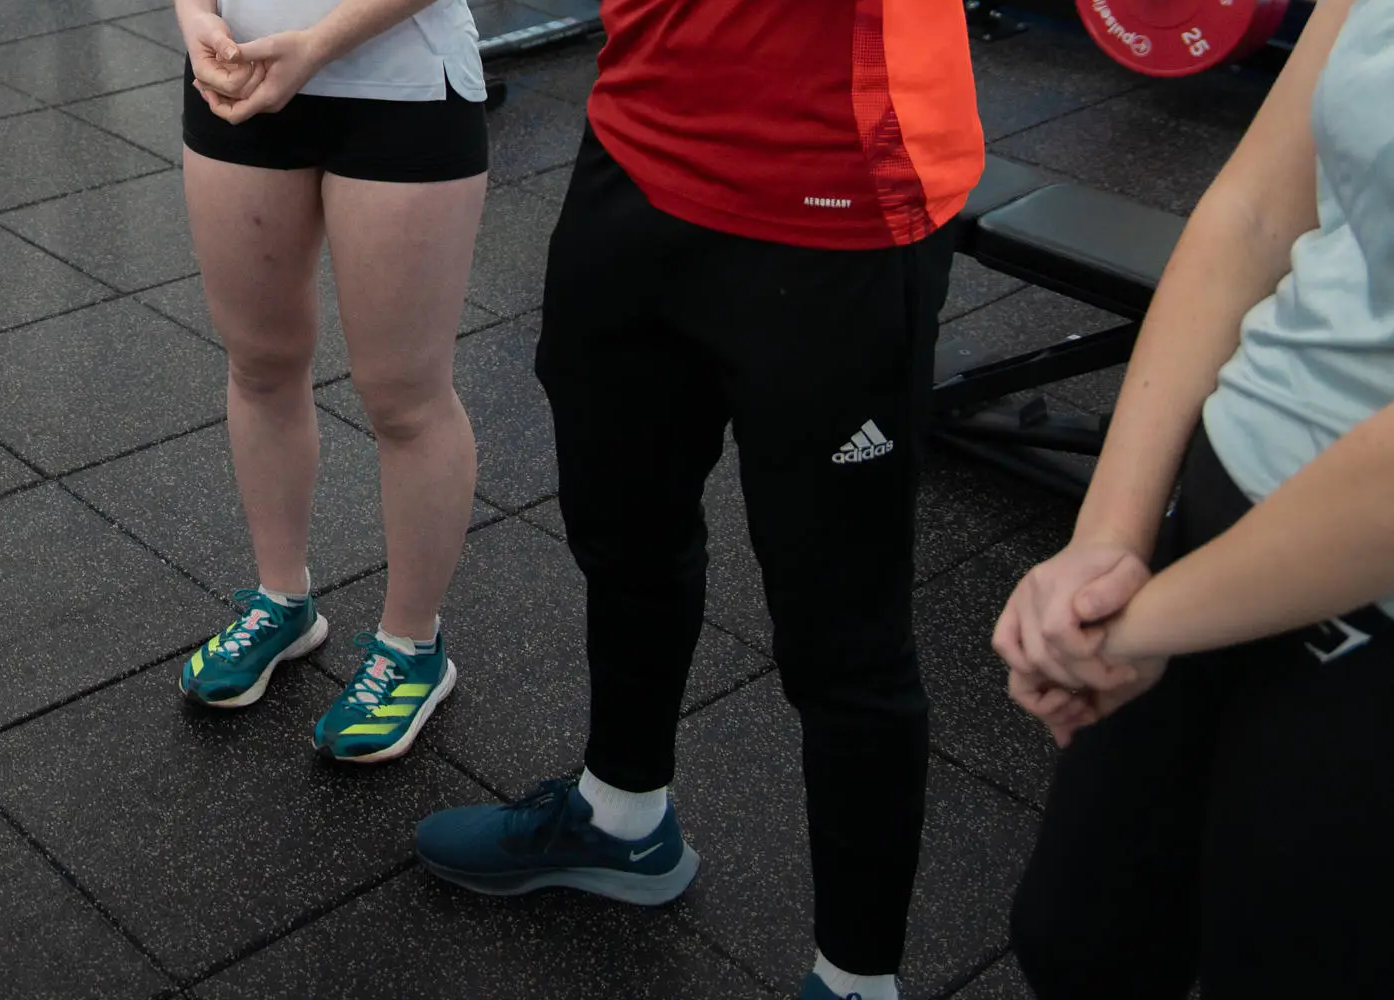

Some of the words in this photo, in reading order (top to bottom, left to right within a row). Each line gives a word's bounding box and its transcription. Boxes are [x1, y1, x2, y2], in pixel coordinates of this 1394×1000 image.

[1181, 27, 1210, 58] 25
[803, 196, 852, 209] AEROREADY
[832, 439, 894, 465] adidas
